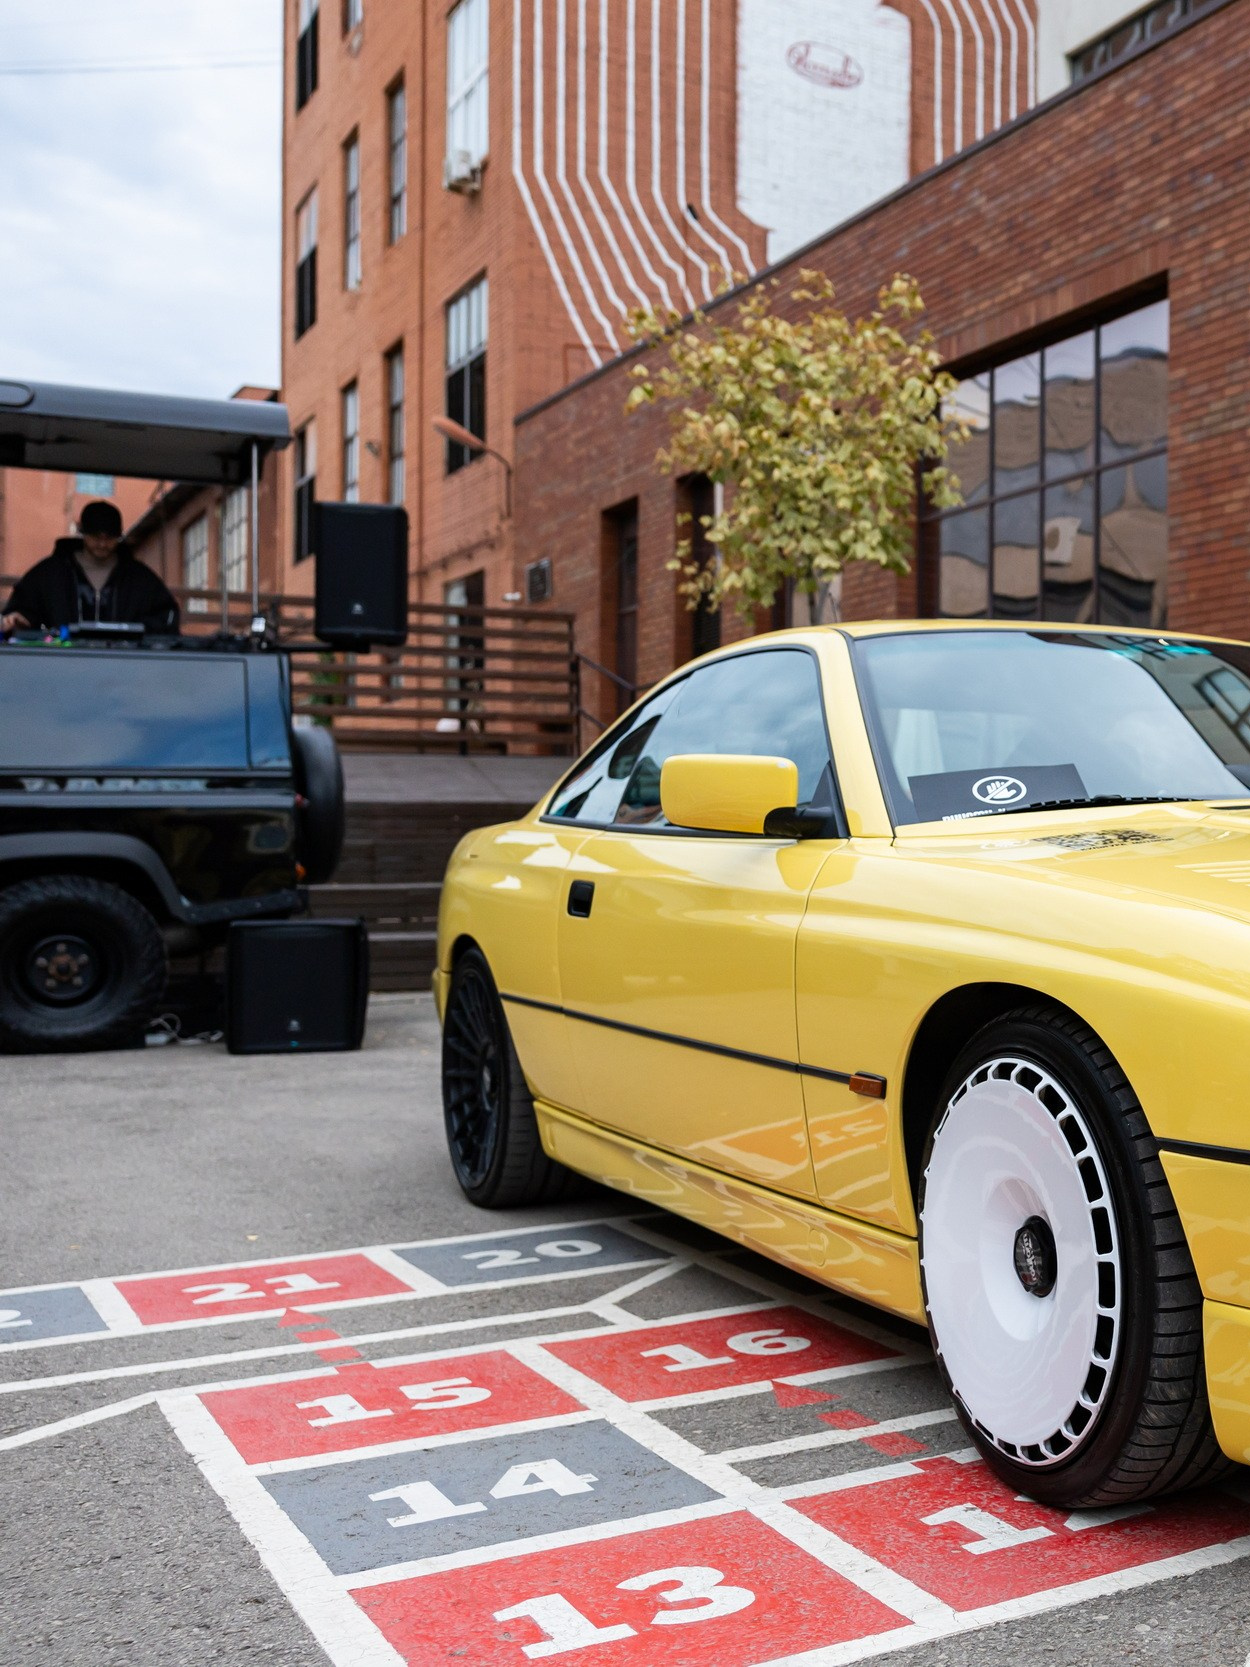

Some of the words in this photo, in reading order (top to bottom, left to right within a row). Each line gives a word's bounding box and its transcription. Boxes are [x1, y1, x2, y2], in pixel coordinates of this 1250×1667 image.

[461, 1239, 603, 1270] 20
[181, 1273, 341, 1305] 21
[640, 1328, 812, 1373] 16
[295, 1377, 492, 1428] 15
[368, 1458, 600, 1528] 14
[492, 1566, 756, 1660] 13
